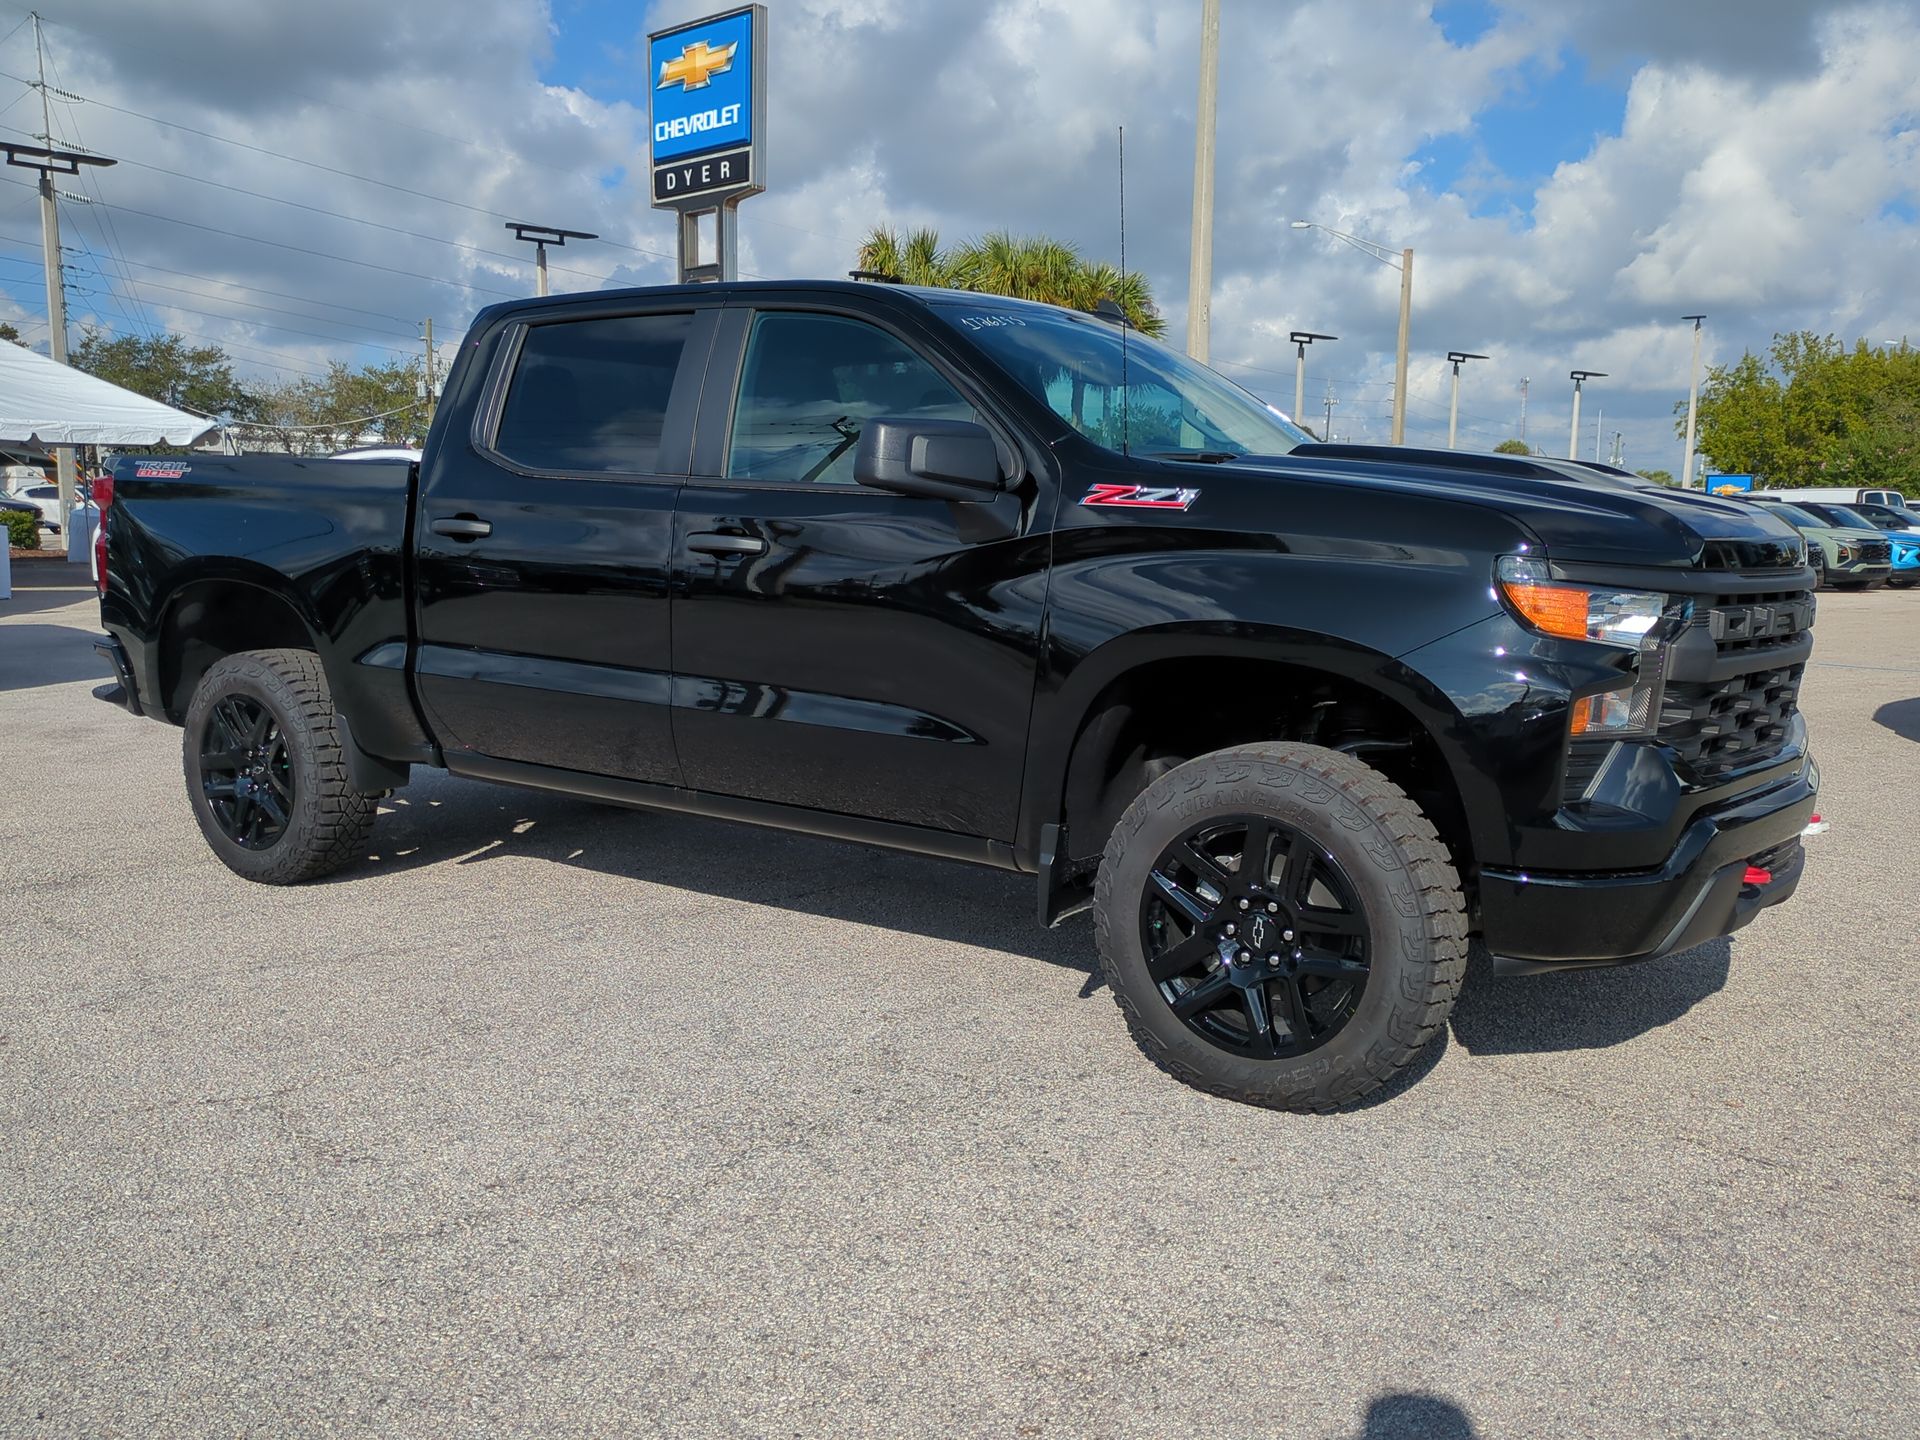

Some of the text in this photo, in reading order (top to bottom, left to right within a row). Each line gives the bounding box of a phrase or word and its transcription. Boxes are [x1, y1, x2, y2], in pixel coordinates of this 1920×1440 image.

[655, 103, 741, 142] CHEVROLET
[666, 160, 730, 190] DYER
[135, 460, 192, 473] TRAIL
[136, 469, 183, 479] BOSS
[1077, 483, 1201, 511] Z71
[1172, 789, 1320, 828] WRANGLER
